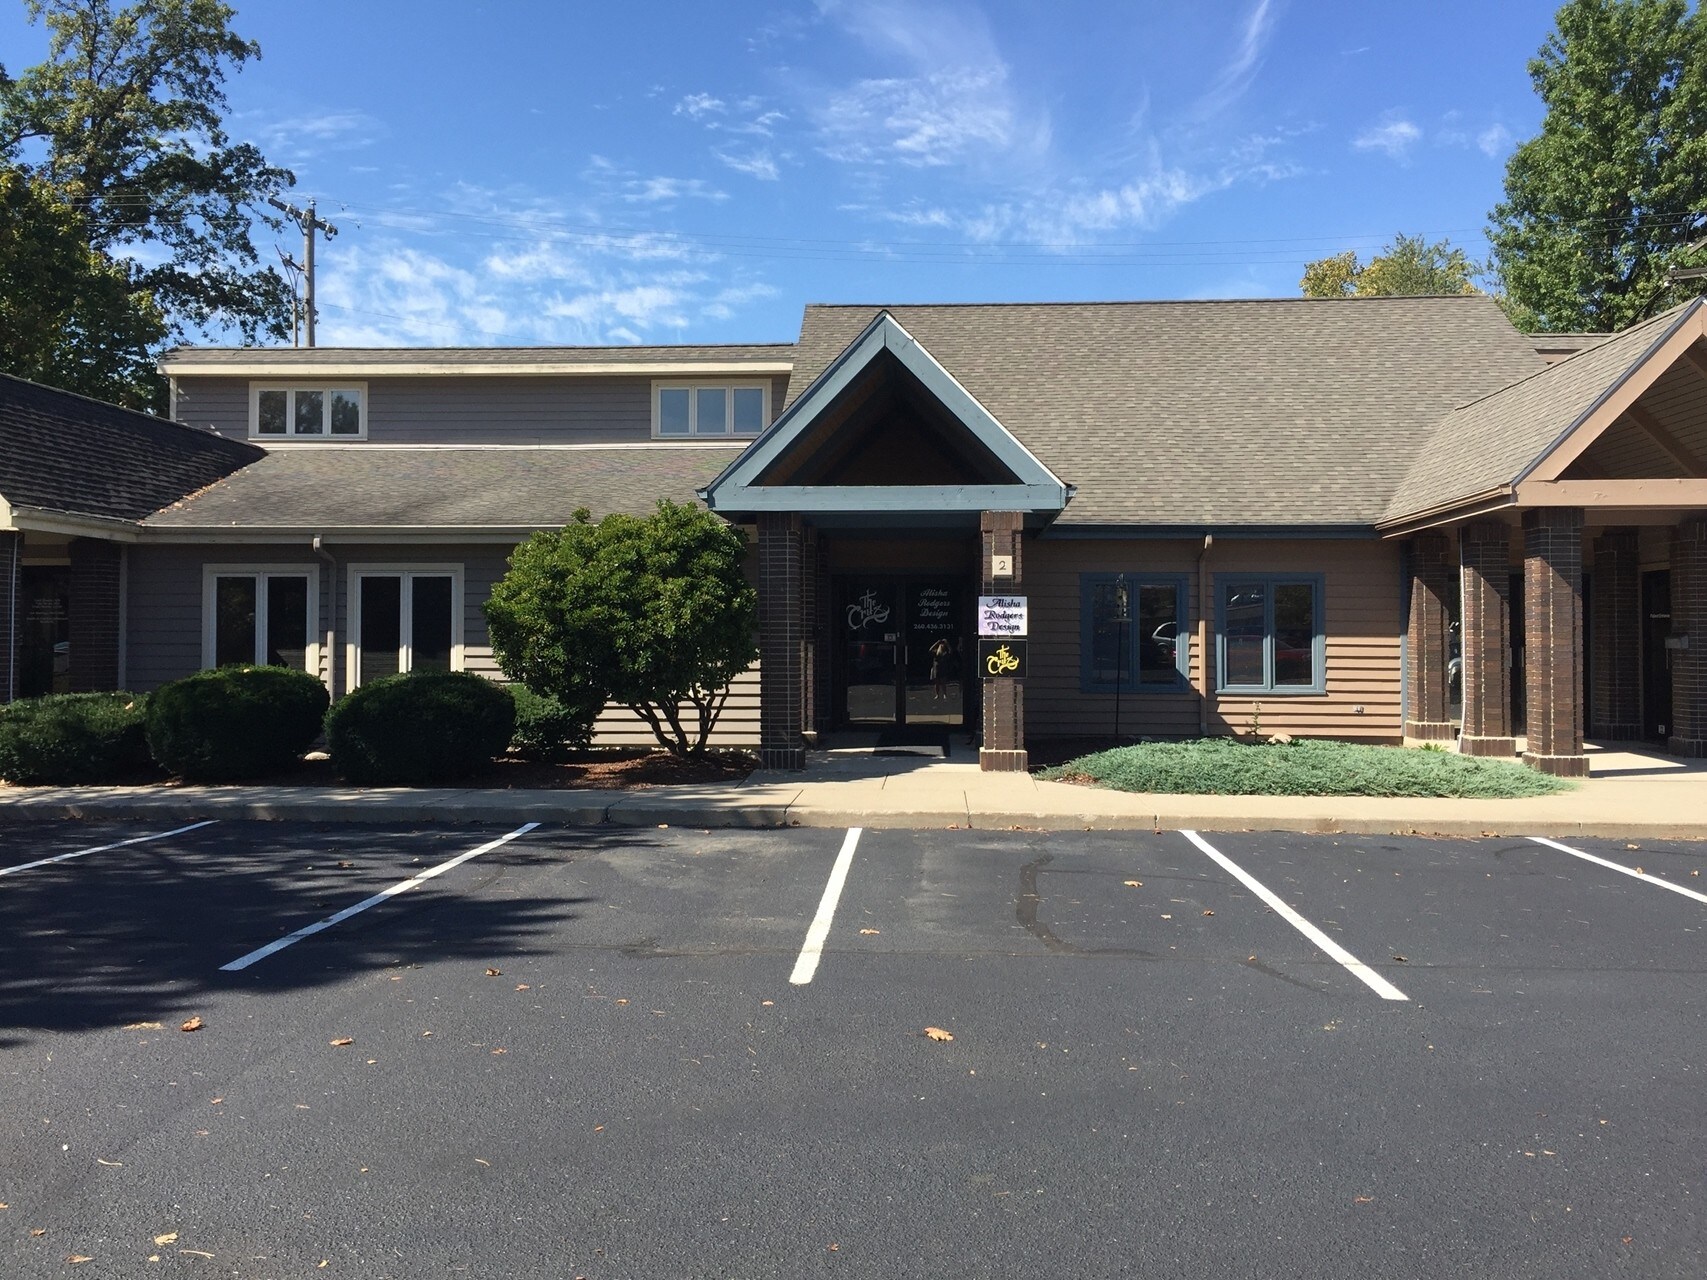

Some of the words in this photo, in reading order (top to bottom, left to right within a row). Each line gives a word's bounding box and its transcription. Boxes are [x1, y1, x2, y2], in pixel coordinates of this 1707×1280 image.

[999, 560, 1006, 571] 2
[986, 598, 1021, 608] Alisha
[919, 608, 949, 620] Design
[984, 610, 1024, 623] Rodgers
[987, 621, 1021, 634] Design
